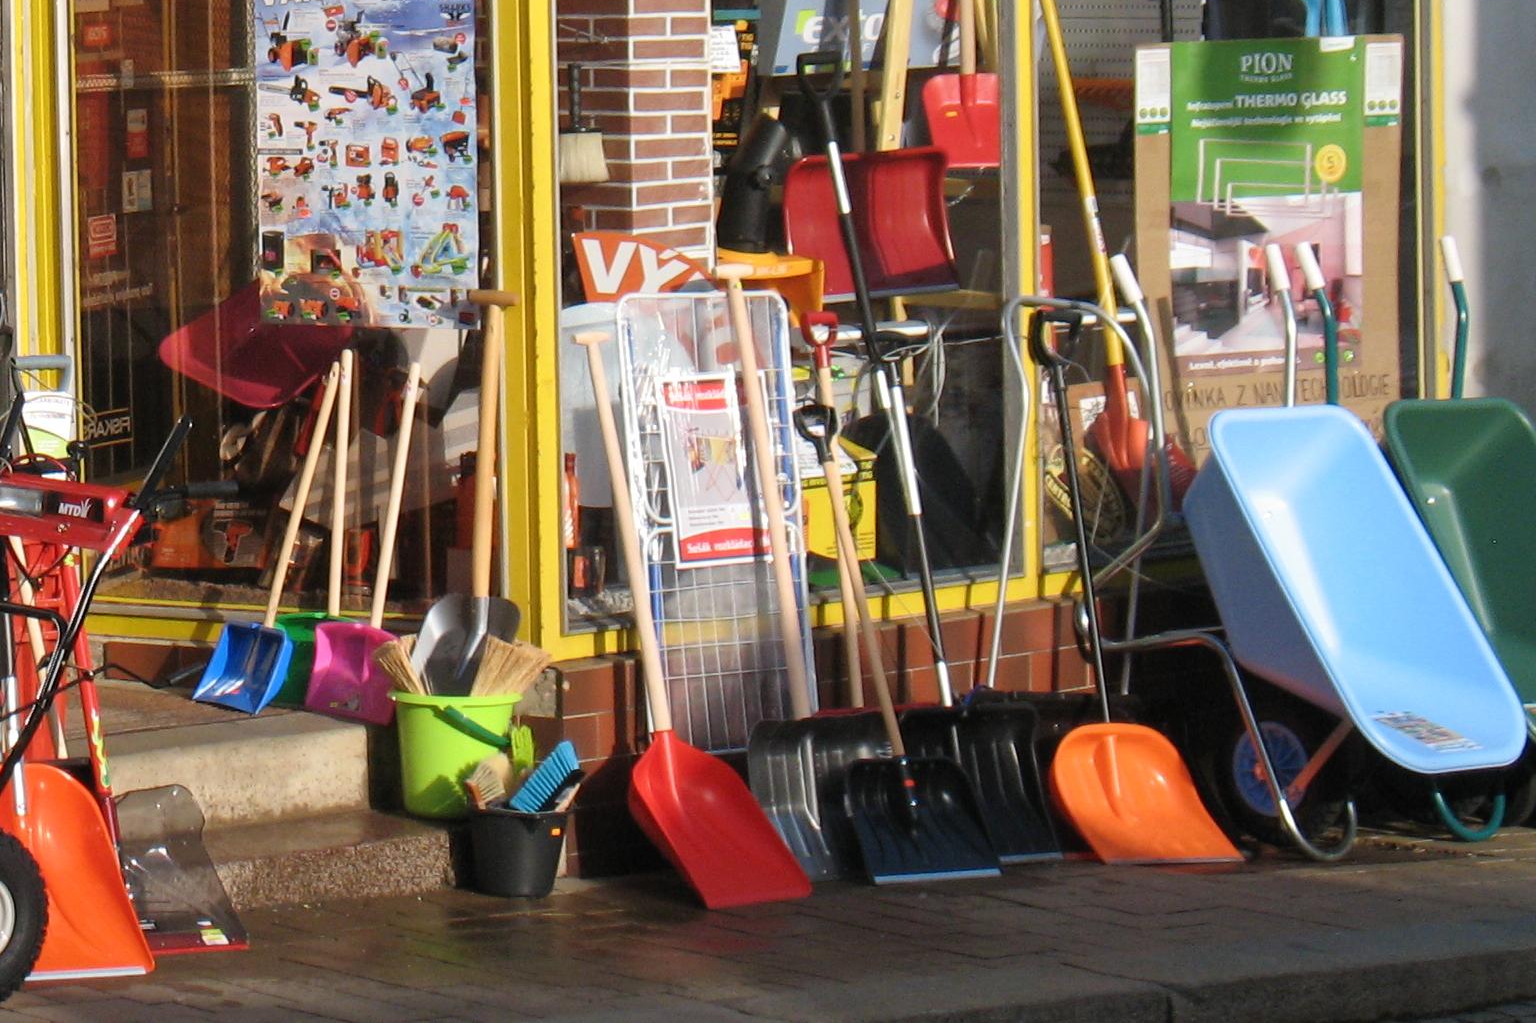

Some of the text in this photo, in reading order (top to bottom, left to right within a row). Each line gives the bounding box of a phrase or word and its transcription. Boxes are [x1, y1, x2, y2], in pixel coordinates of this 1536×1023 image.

[1239, 52, 1294, 75] PION
[1234, 93, 1297, 109] THERMO
[1299, 90, 1348, 109] GLASS
[58, 501, 81, 518] MTD
